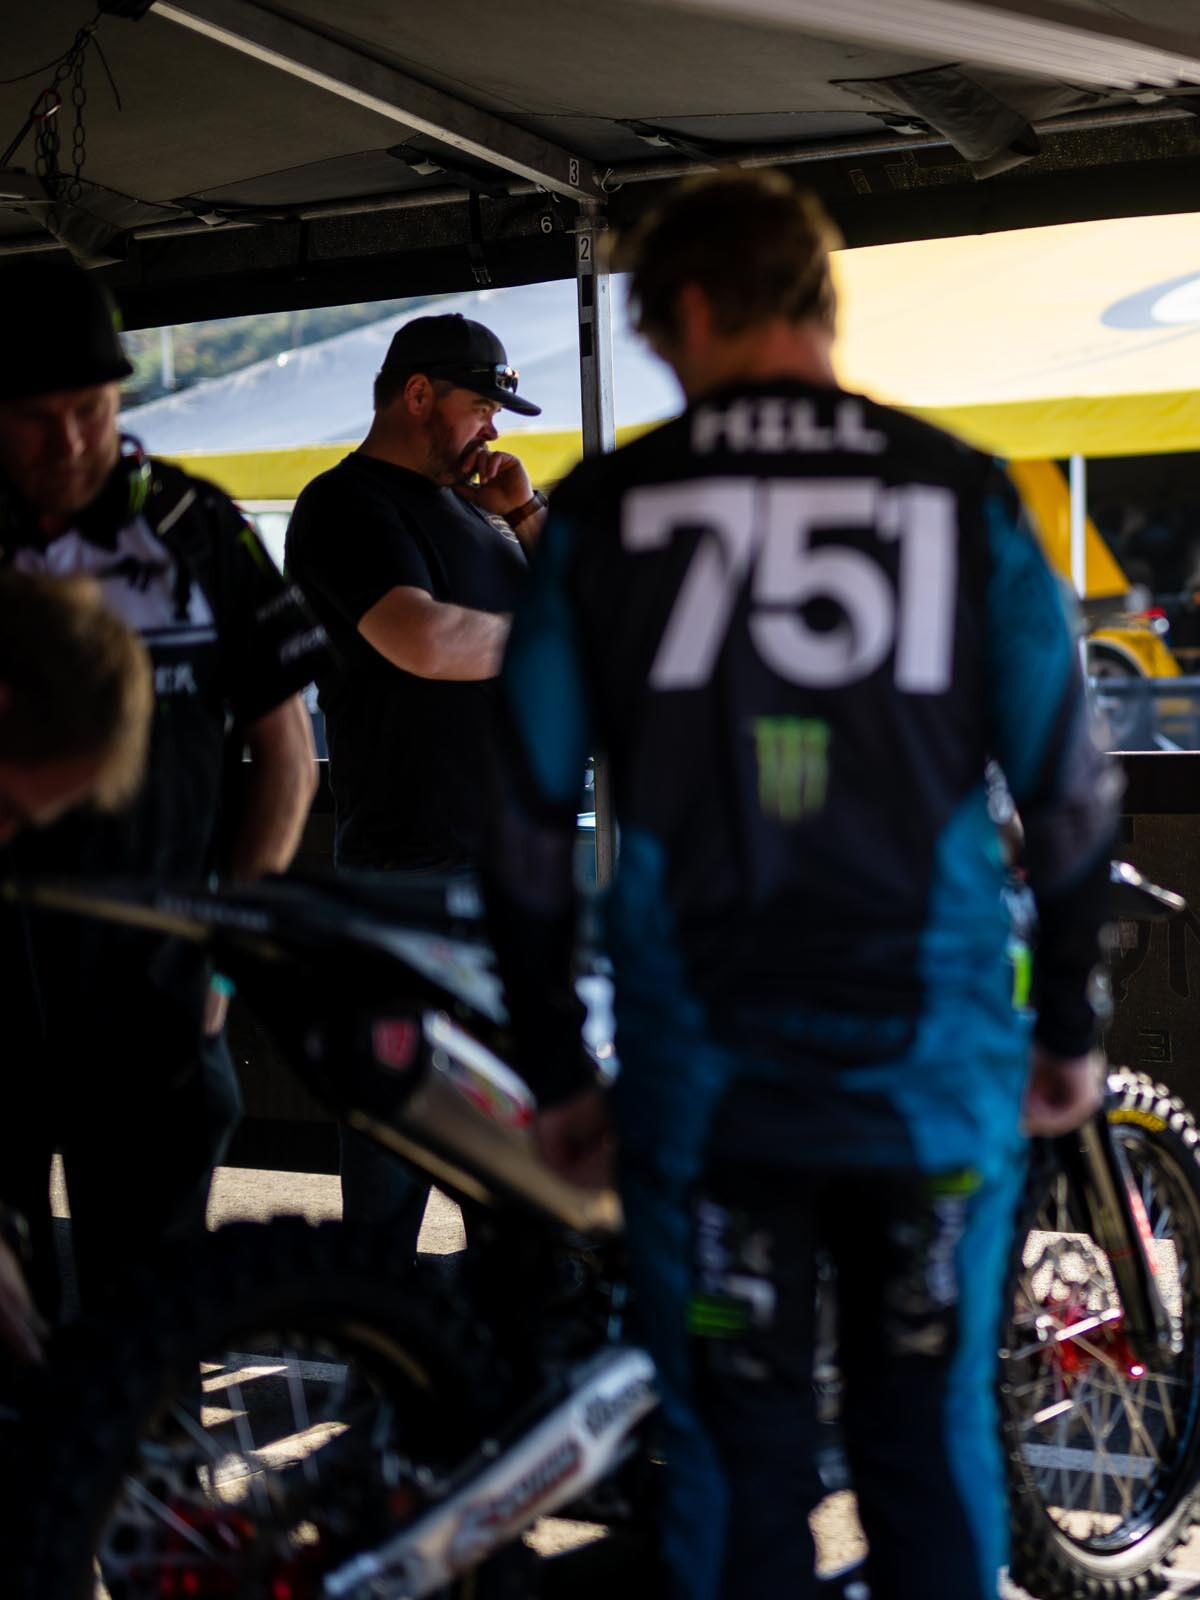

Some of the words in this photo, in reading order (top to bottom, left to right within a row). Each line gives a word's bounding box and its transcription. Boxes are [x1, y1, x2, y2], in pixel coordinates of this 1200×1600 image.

[570, 161, 578, 184] 3
[540, 216, 553, 234] 6
[580, 238, 590, 260] 2
[691, 399, 887, 453] HILL
[621, 475, 958, 694] 751
